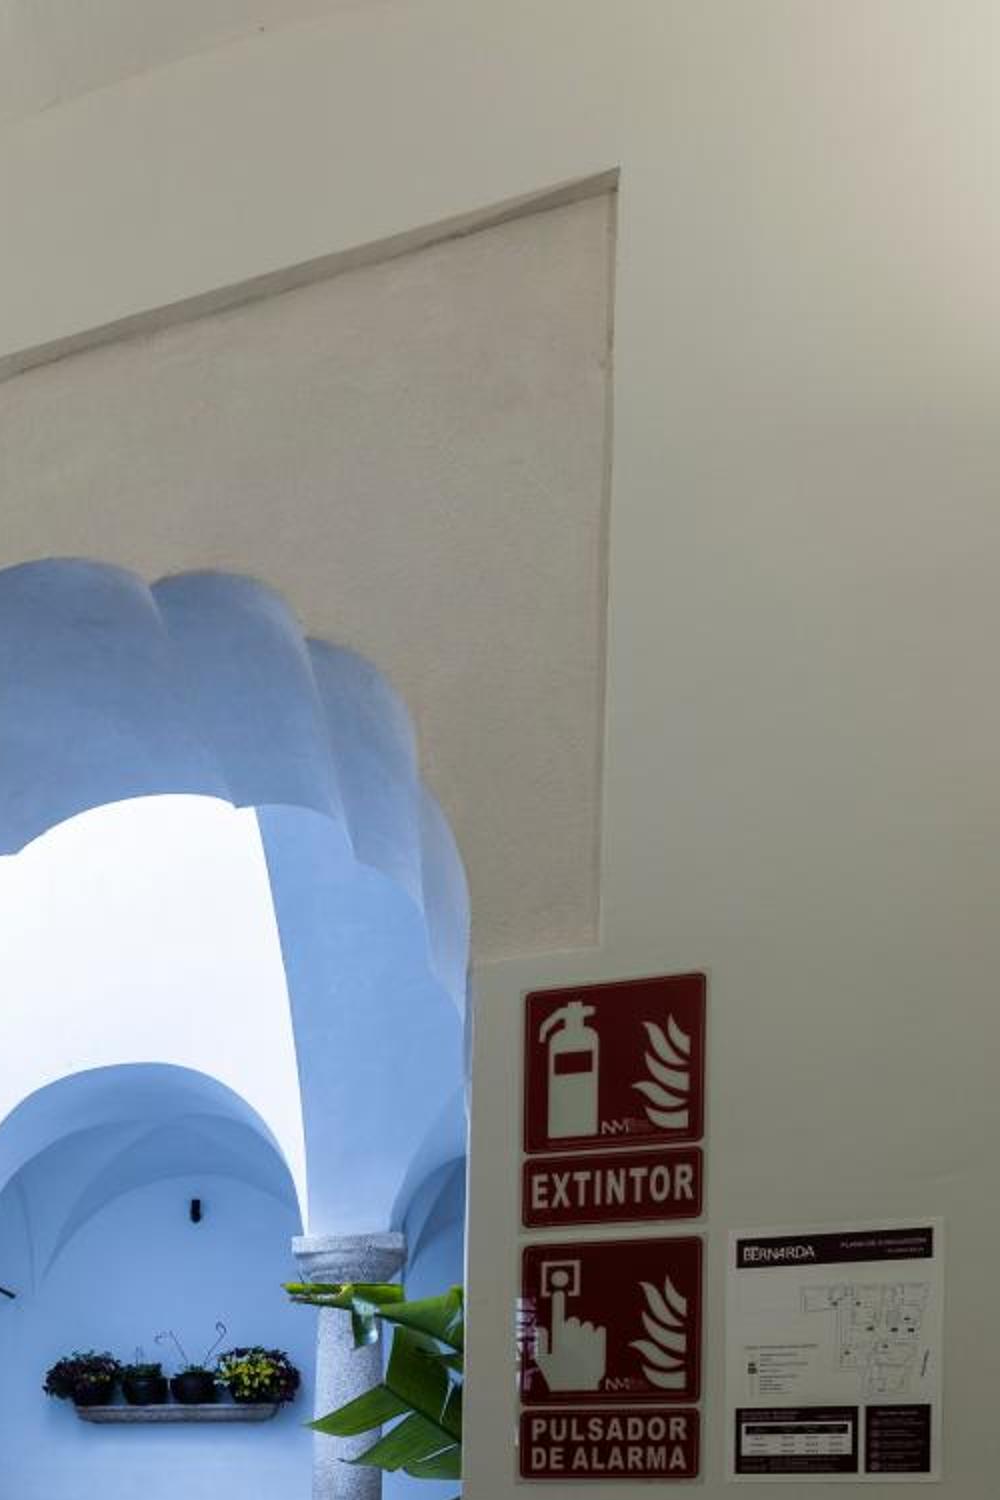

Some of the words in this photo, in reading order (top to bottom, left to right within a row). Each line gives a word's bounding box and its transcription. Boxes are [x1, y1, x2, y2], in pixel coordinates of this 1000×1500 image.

[531, 1164, 693, 1208] EXTINTOR
[531, 1417, 688, 1441] PULSADOR
[531, 1447, 564, 1470] DE
[571, 1446, 687, 1470] ALARMA
